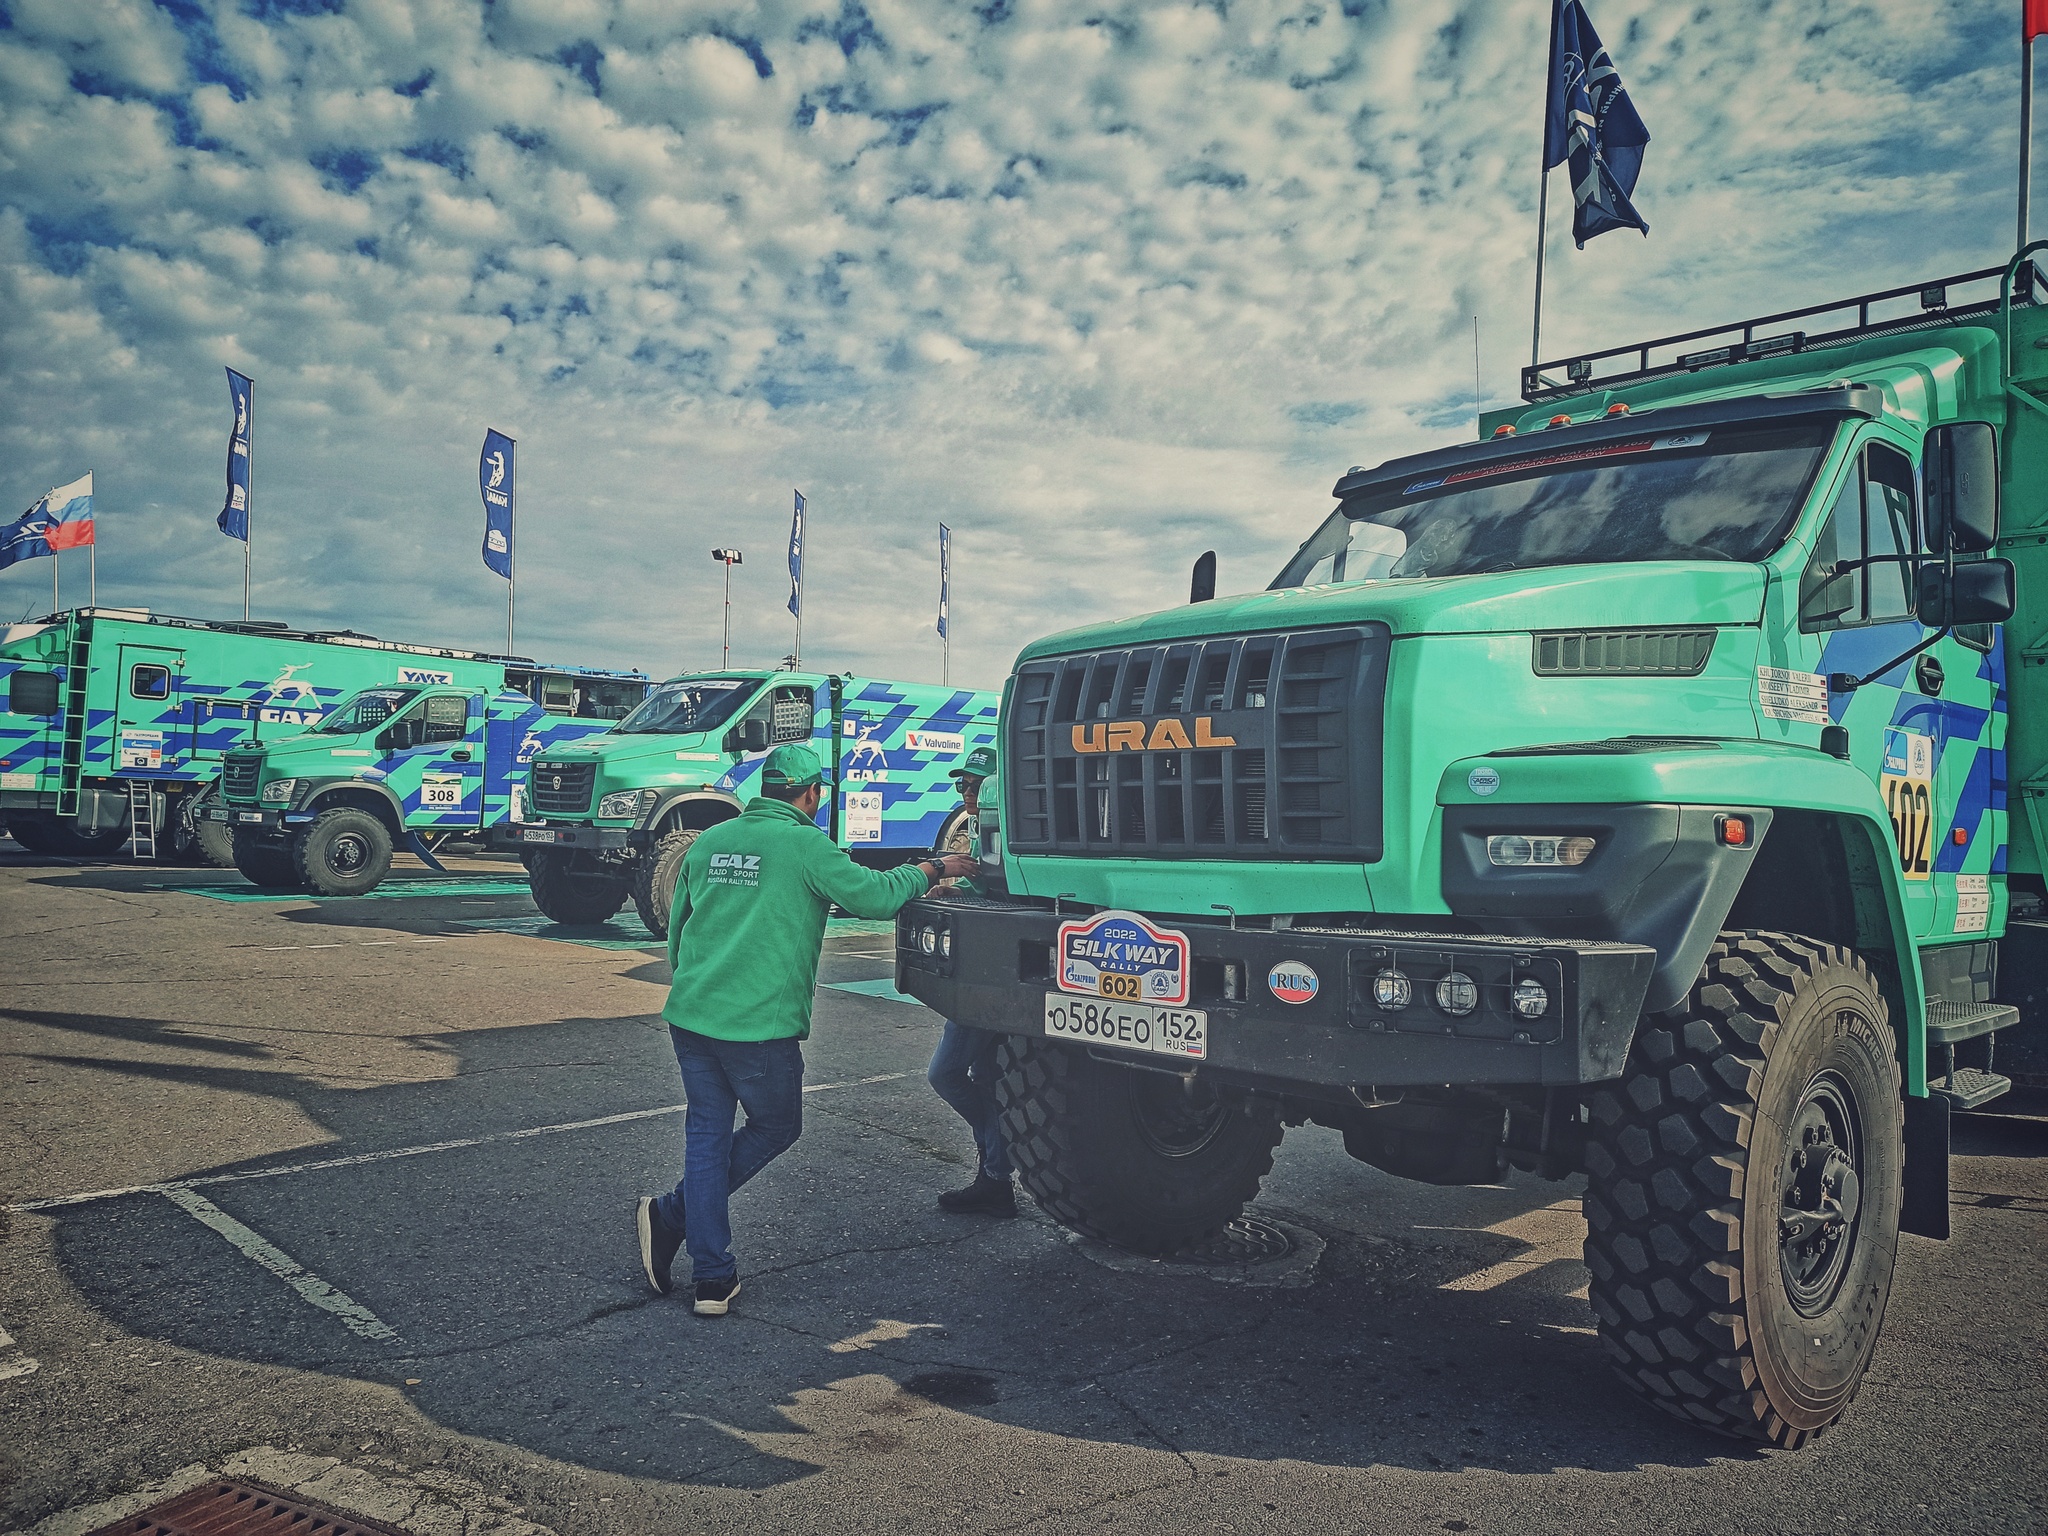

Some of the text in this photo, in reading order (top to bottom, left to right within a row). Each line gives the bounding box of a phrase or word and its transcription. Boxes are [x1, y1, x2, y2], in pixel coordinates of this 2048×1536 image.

[1554, 450, 1607, 463] MOSCOW
[259, 708, 324, 726] GAZ
[1072, 717, 1237, 753] URAL
[924, 738, 961, 750] Valvoline
[516, 755, 533, 763] GA
[846, 769, 888, 783] GAZ
[428, 789, 454, 802] 308
[710, 853, 761, 870] GAZ
[708, 868, 759, 879] RAID SPORT
[744, 879, 759, 887] TEAM
[1104, 928, 1137, 941] 2022
[1071, 939, 1174, 965] SILK WAY
[1100, 961, 1142, 972] RALLY
[1102, 975, 1138, 998] 602
[1276, 973, 1311, 992] RUS
[1156, 1011, 1197, 1042] 152
[1165, 1039, 1186, 1051] RUS
